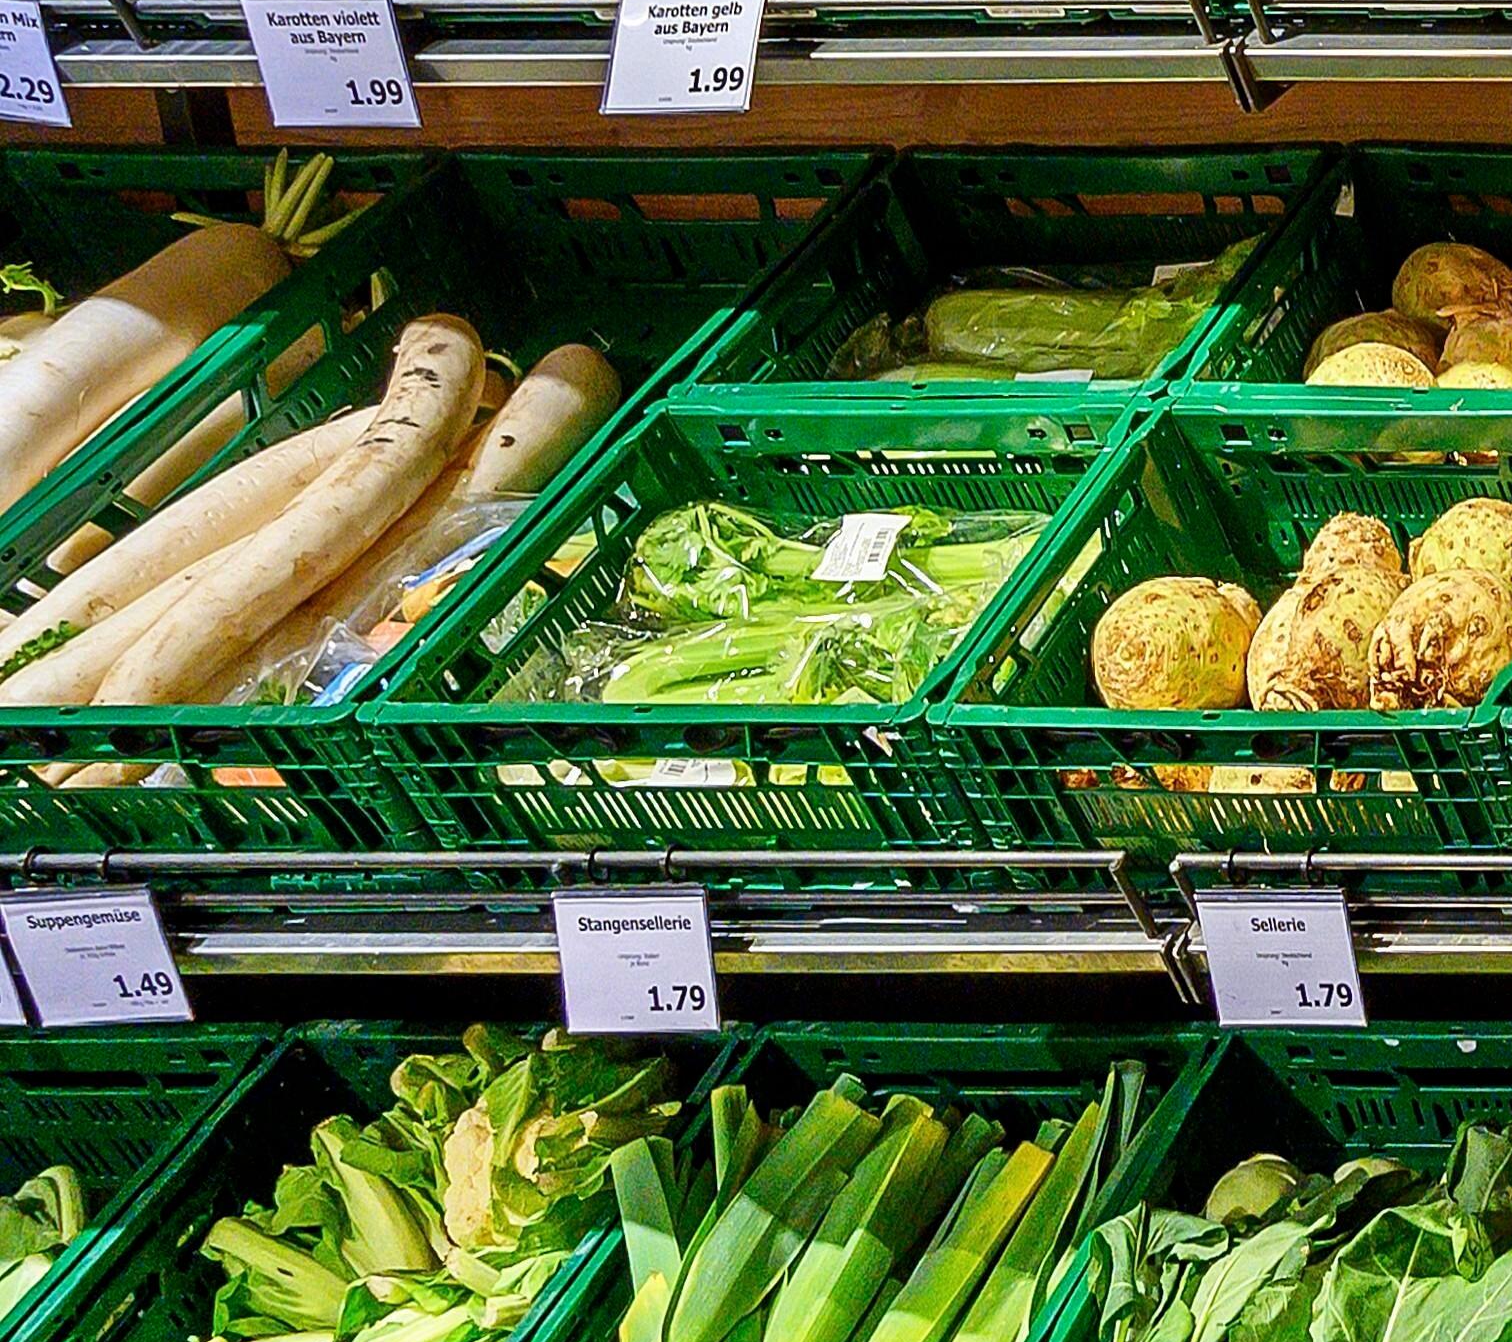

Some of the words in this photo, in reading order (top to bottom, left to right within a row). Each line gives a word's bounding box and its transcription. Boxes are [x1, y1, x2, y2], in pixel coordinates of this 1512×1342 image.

[11, 11, 40, 29] Mix
[266, 12, 331, 27] Karotten
[332, 10, 381, 26] violett
[648, 4, 708, 19] Karotten
[711, 1, 743, 20] gelb
[289, 32, 316, 45] aus
[316, 29, 367, 47] Bayern
[653, 23, 679, 36] aus
[681, 20, 729, 37] Bayern
[0, 73, 55, 104] 2.29
[688, 66, 745, 93] 1.99
[345, 79, 404, 106] 1.99
[26, 908, 142, 932] Suppengemüse
[578, 914, 692, 935] Stangensellerie
[1250, 917, 1306, 933] Sellerie
[112, 971, 174, 998] 1.49
[1295, 982, 1353, 1008] 1.79
[647, 985, 706, 1012] 1.79
